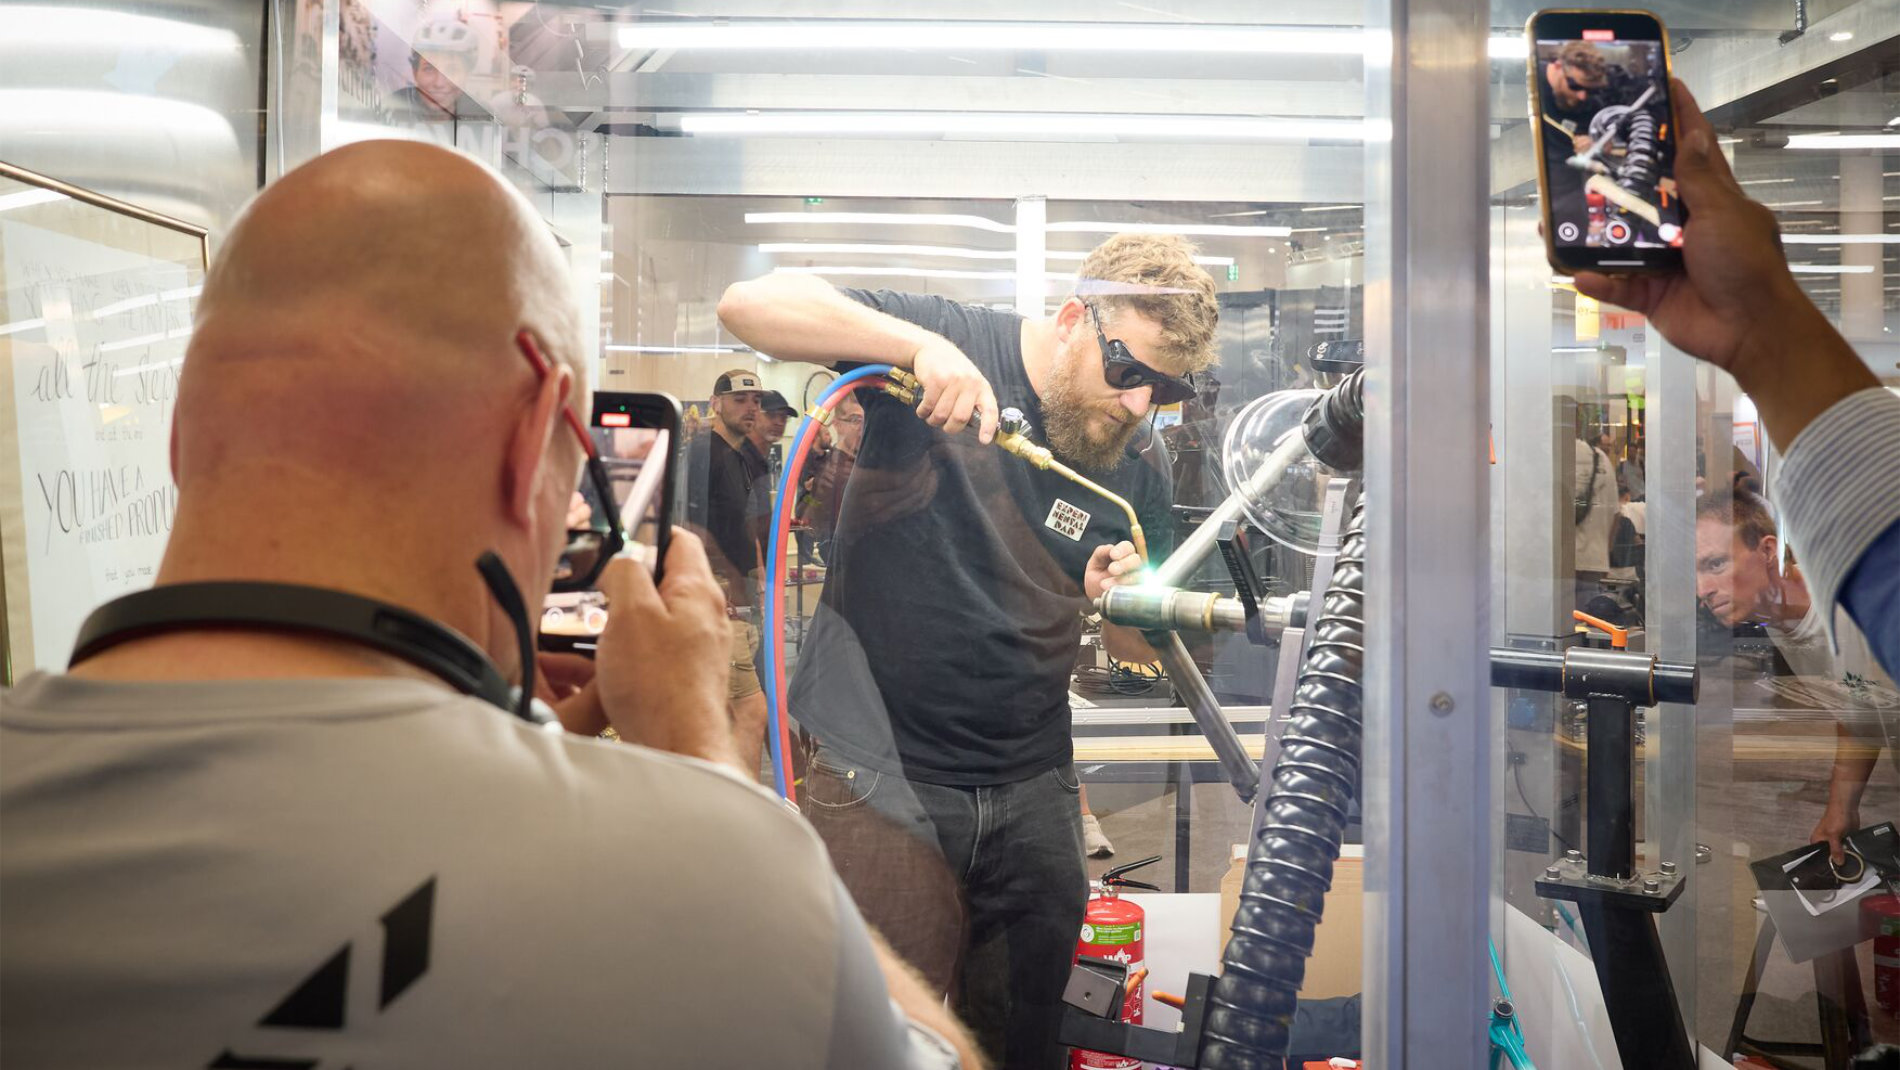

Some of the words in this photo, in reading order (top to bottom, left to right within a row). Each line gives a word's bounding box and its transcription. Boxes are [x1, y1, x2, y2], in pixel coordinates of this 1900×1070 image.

[82, 340, 122, 406] the
[37, 466, 86, 557] YOU
[89, 462, 132, 521] HAVE
[135, 464, 146, 492] A
[79, 512, 125, 546] FINISHED
[1054, 520, 1075, 535] DAD
